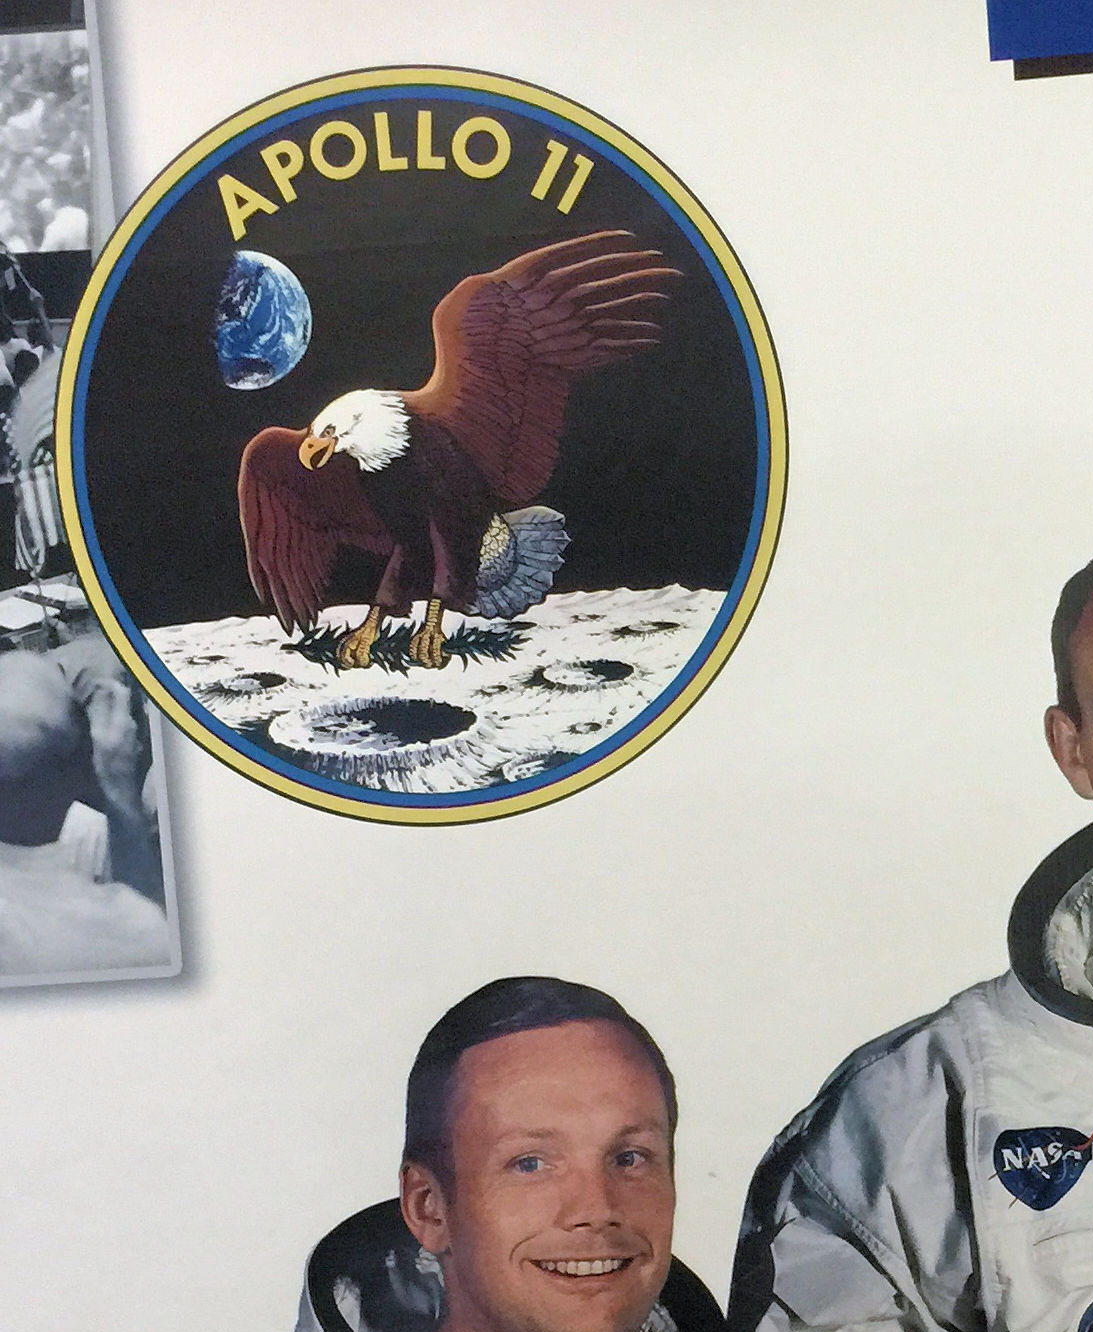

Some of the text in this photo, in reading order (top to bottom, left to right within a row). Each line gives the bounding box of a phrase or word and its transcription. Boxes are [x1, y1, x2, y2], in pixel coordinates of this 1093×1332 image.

[217, 110, 594, 241] APOLLO 11
[1001, 1141, 1082, 1172] NASA
